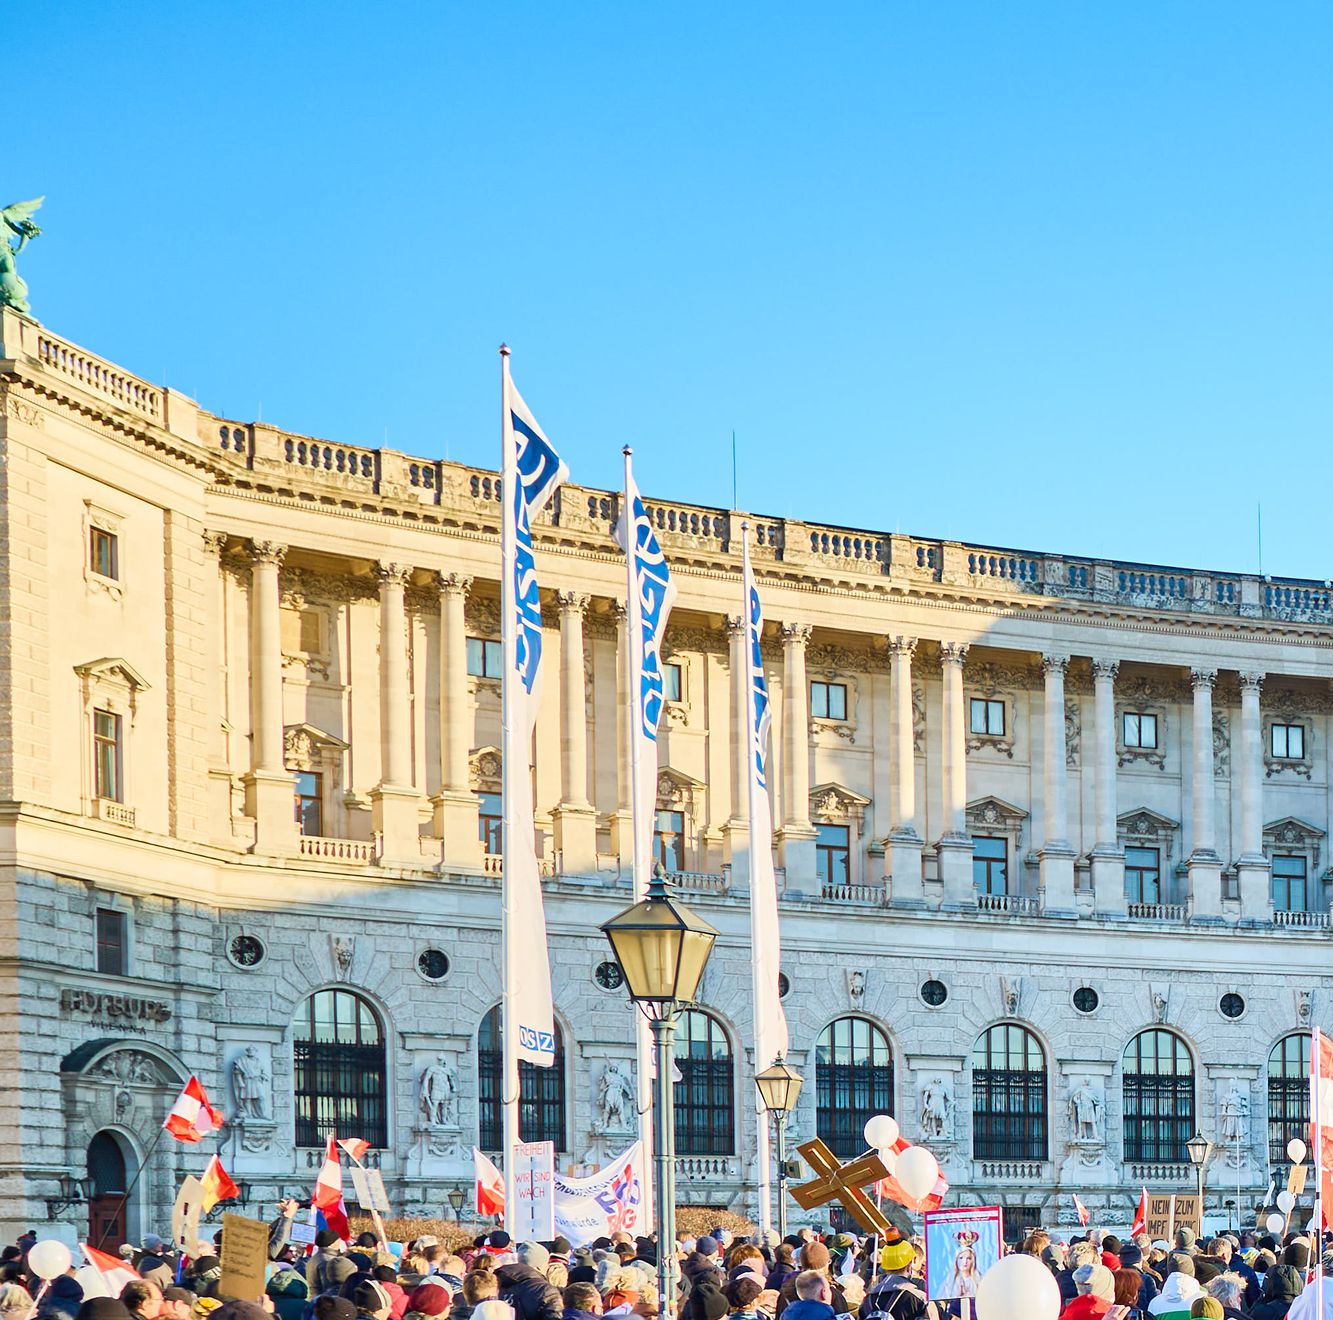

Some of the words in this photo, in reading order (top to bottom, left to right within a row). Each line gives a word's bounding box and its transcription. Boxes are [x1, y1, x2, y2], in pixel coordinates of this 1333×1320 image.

[513, 1143, 550, 1157] FREIHEIT
[515, 1172, 531, 1183] WIR
[534, 1171, 550, 1182] SIND
[1151, 1199, 1170, 1215] NEIN
[1175, 1199, 1194, 1215] ZUM
[1147, 1220, 1168, 1235] IMPF
